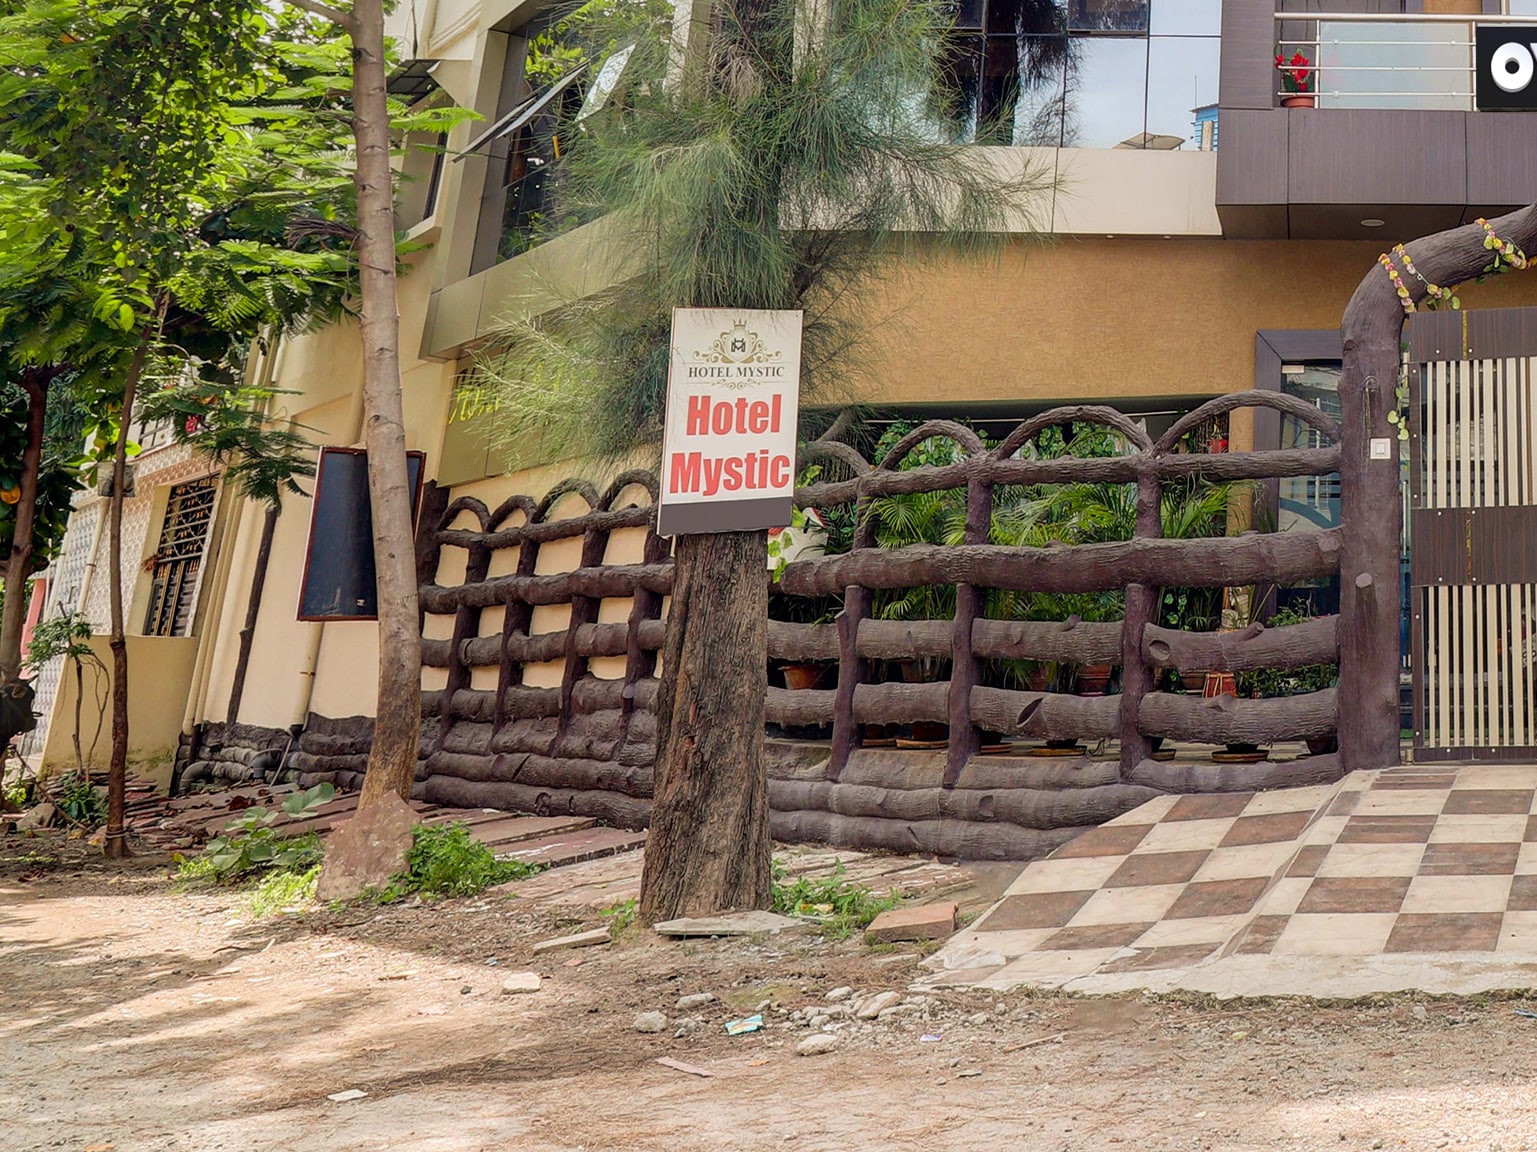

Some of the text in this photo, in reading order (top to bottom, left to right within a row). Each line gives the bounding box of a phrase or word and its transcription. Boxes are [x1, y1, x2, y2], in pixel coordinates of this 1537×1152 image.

[688, 366, 785, 379] HOTEL MYSTIC
[686, 394, 782, 437] Hotel
[669, 449, 791, 496] Mystic
